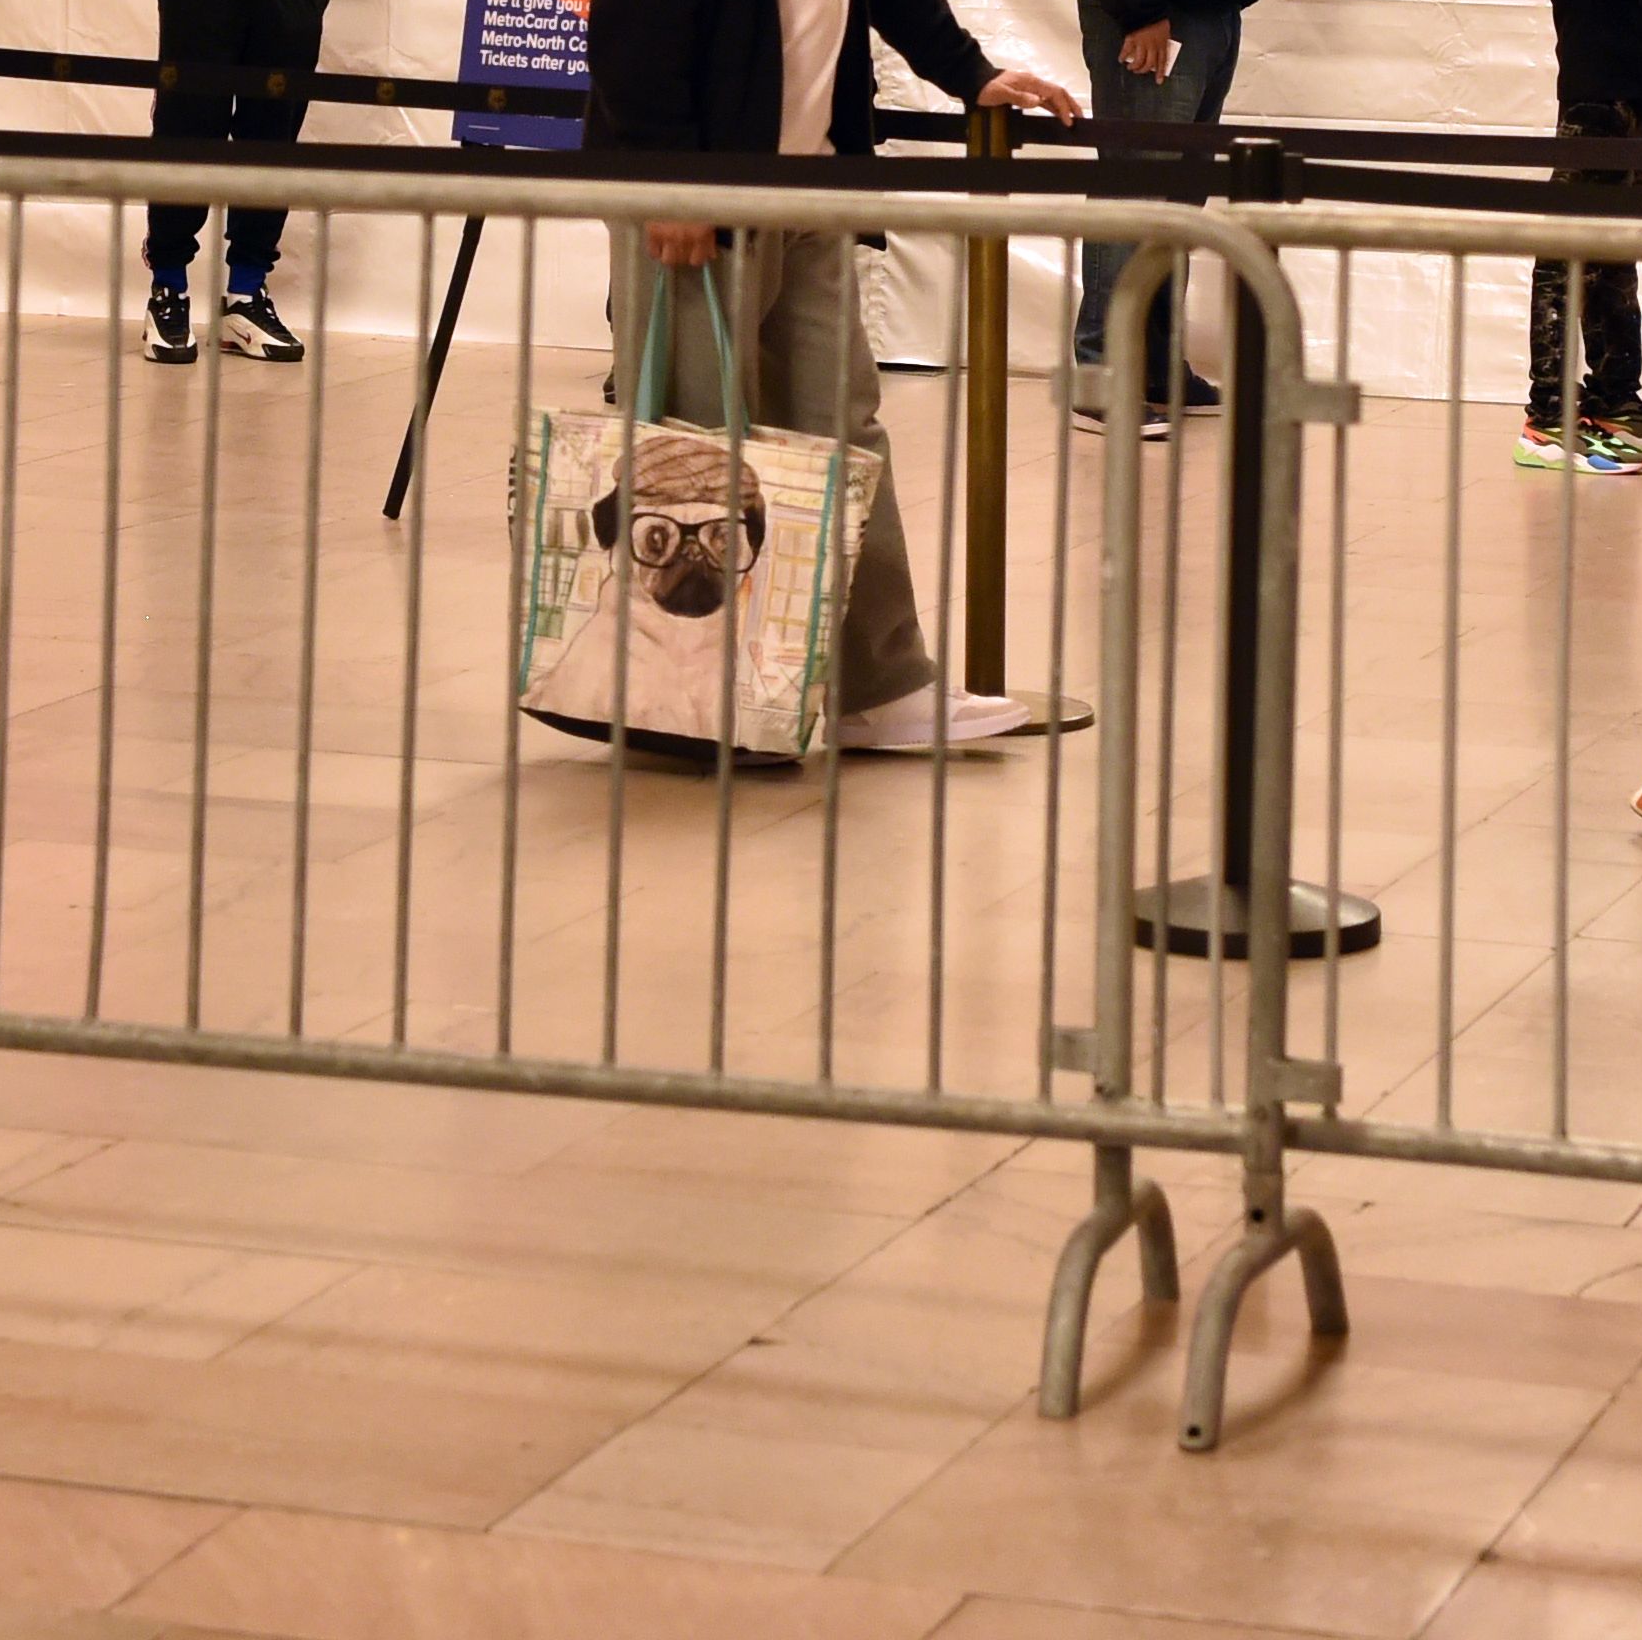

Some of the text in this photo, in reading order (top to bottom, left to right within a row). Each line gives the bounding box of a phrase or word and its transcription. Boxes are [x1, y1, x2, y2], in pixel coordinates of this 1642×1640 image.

[556, 0, 582, 14] you
[484, 10, 558, 30] MetroCard
[561, 18, 575, 31] or
[481, 30, 565, 51] Metro-North
[480, 50, 529, 68] Tickets
[531, 53, 565, 71] after
